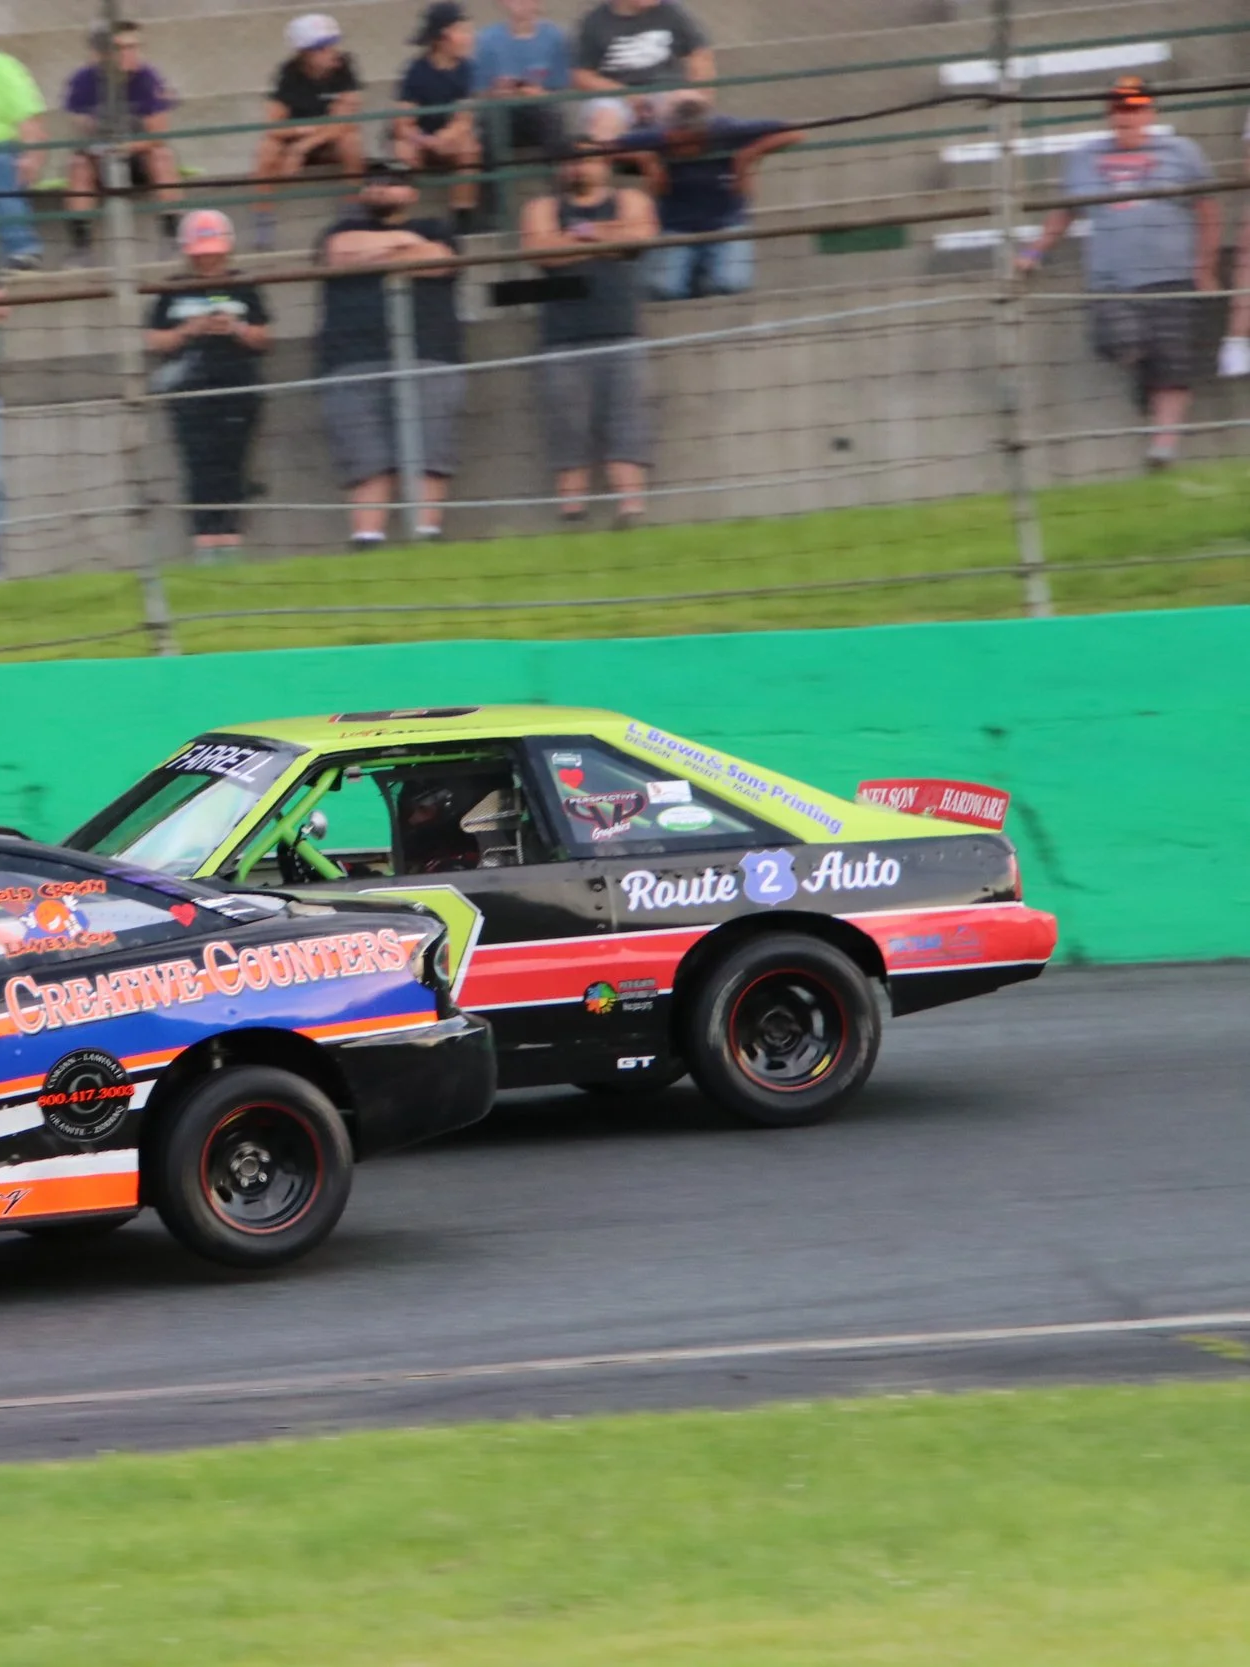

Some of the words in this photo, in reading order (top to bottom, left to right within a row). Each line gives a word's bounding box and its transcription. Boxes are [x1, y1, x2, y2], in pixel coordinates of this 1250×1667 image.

[165, 744, 274, 783] FARRELL
[623, 733, 671, 760] DESIGN
[646, 728, 705, 763] Brown
[726, 763, 768, 793] Sons
[770, 784, 845, 835] Printing
[860, 786, 920, 810] NELSON
[938, 787, 1007, 823] HARDWARE
[620, 866, 740, 912] Route
[756, 859, 783, 894] 2
[801, 850, 901, 893] Auto
[3, 958, 205, 1036] CREATIVE
[202, 927, 408, 997] COUNTERS
[616, 1055, 656, 1070] GT
[36, 1083, 135, 1108] 800.417.3003
